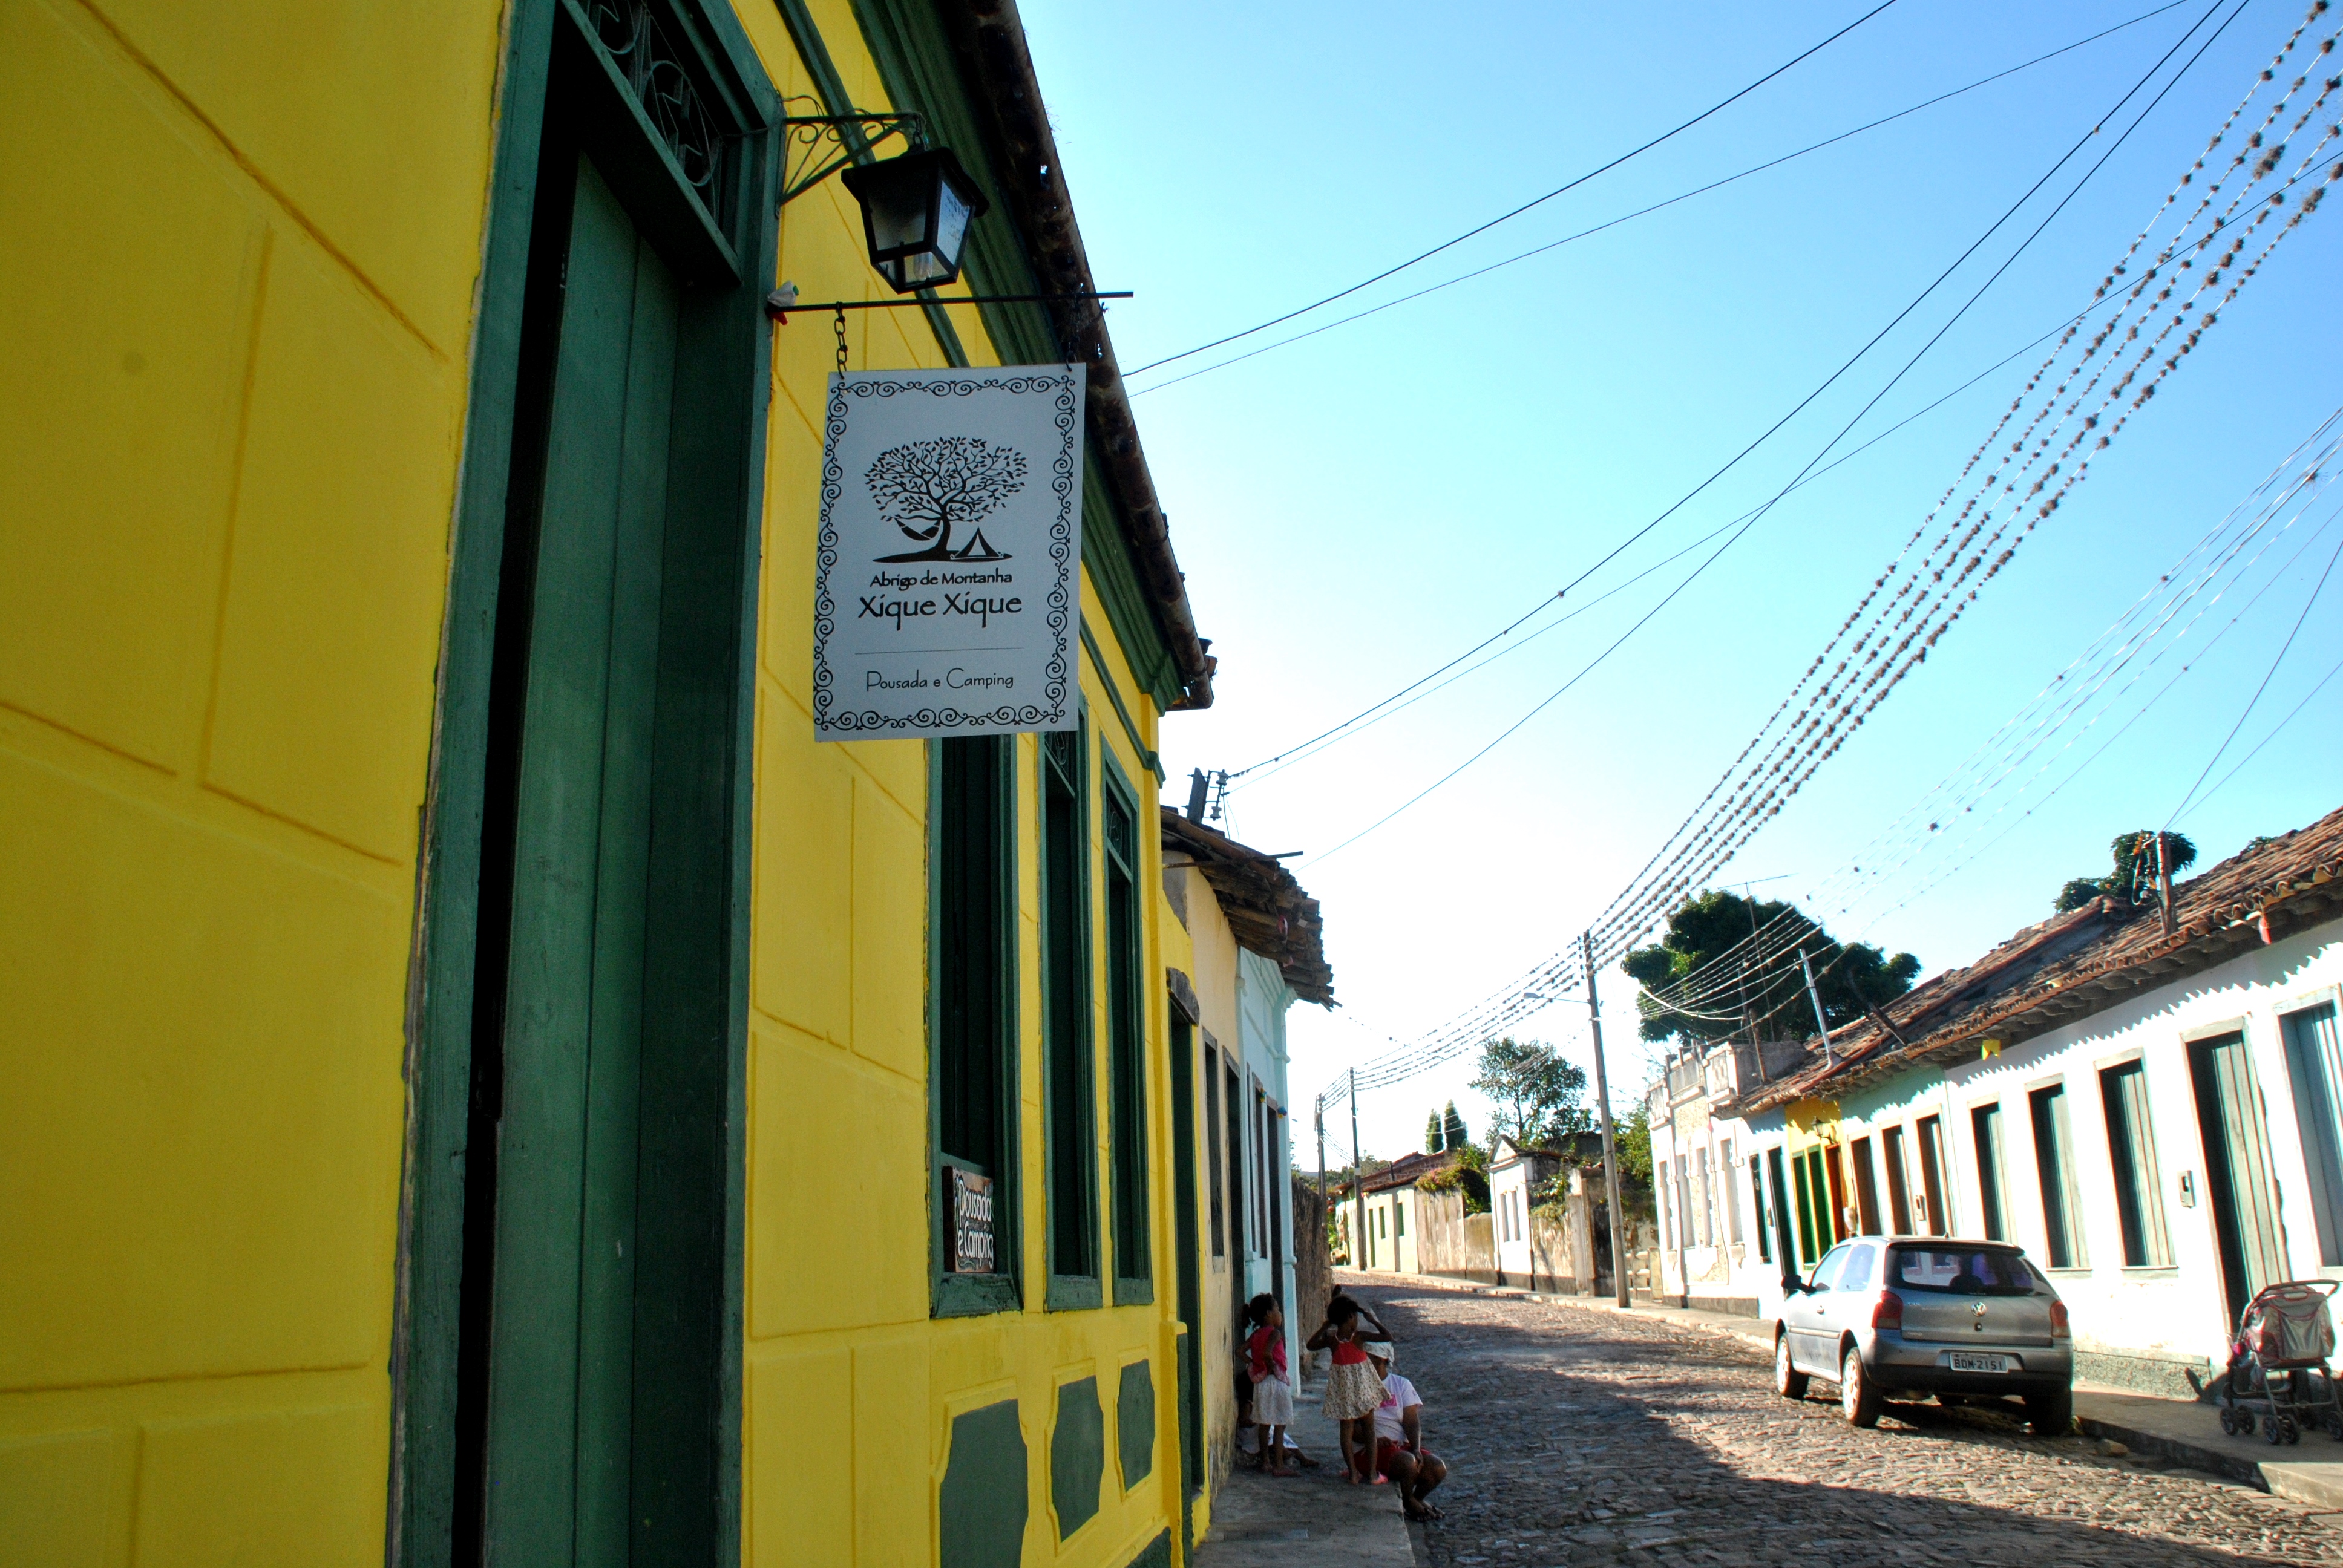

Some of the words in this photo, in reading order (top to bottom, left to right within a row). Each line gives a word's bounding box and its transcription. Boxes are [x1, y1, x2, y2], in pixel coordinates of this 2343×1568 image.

[870, 570, 918, 592] Abrigo
[920, 569, 939, 586] de
[942, 567, 1012, 584] Montanha
[867, 668, 928, 692] Pousada
[932, 679, 941, 687] e
[946, 667, 1014, 689] Camping
[958, 1179, 992, 1229] Pousada
[957, 1229, 964, 1258] e
[964, 1220, 994, 1270] Camping
